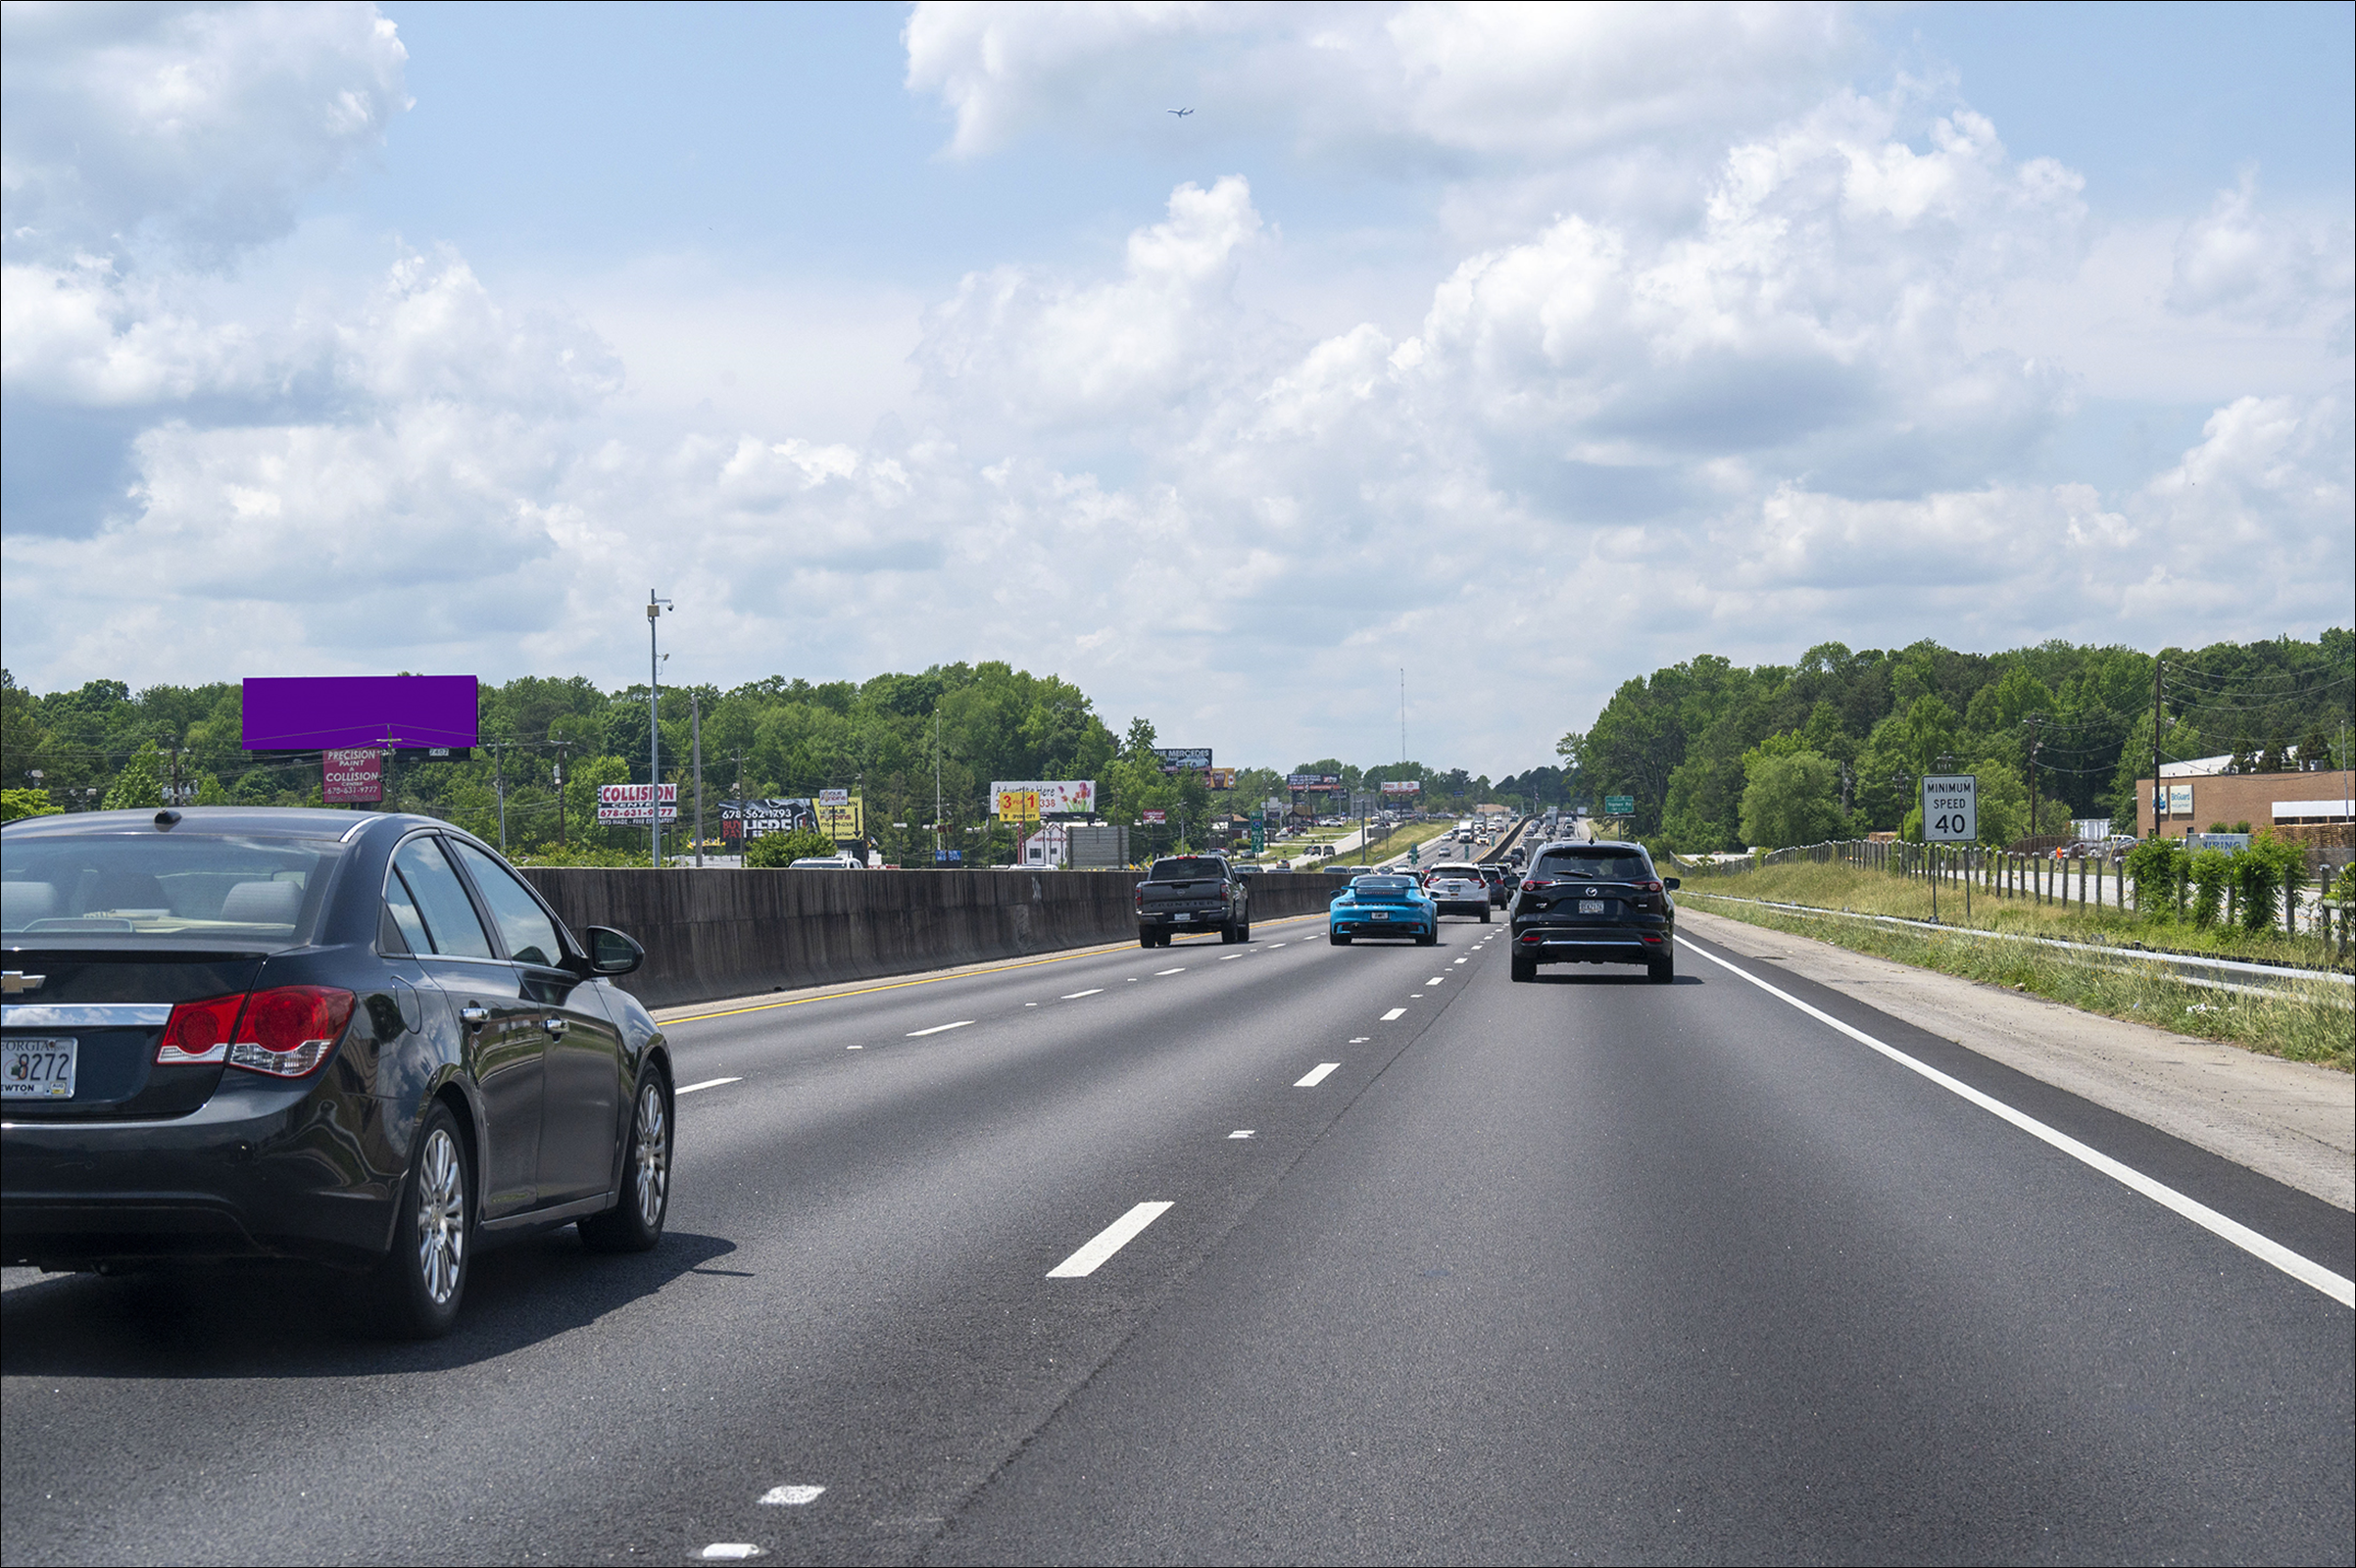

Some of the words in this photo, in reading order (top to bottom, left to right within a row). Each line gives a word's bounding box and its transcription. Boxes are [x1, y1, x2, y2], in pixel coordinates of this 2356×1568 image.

[327, 750, 375, 760] PRECISION
[325, 772, 378, 782] COLLISION
[1927, 783, 1971, 793] MINIMUM
[1934, 799, 1966, 808] SPEED
[600, 808, 673, 817] 678-631-977
[1935, 814, 1965, 834] 40
[1, 1041, 49, 1052] EORGIA
[19, 1054, 70, 1081] 8272
